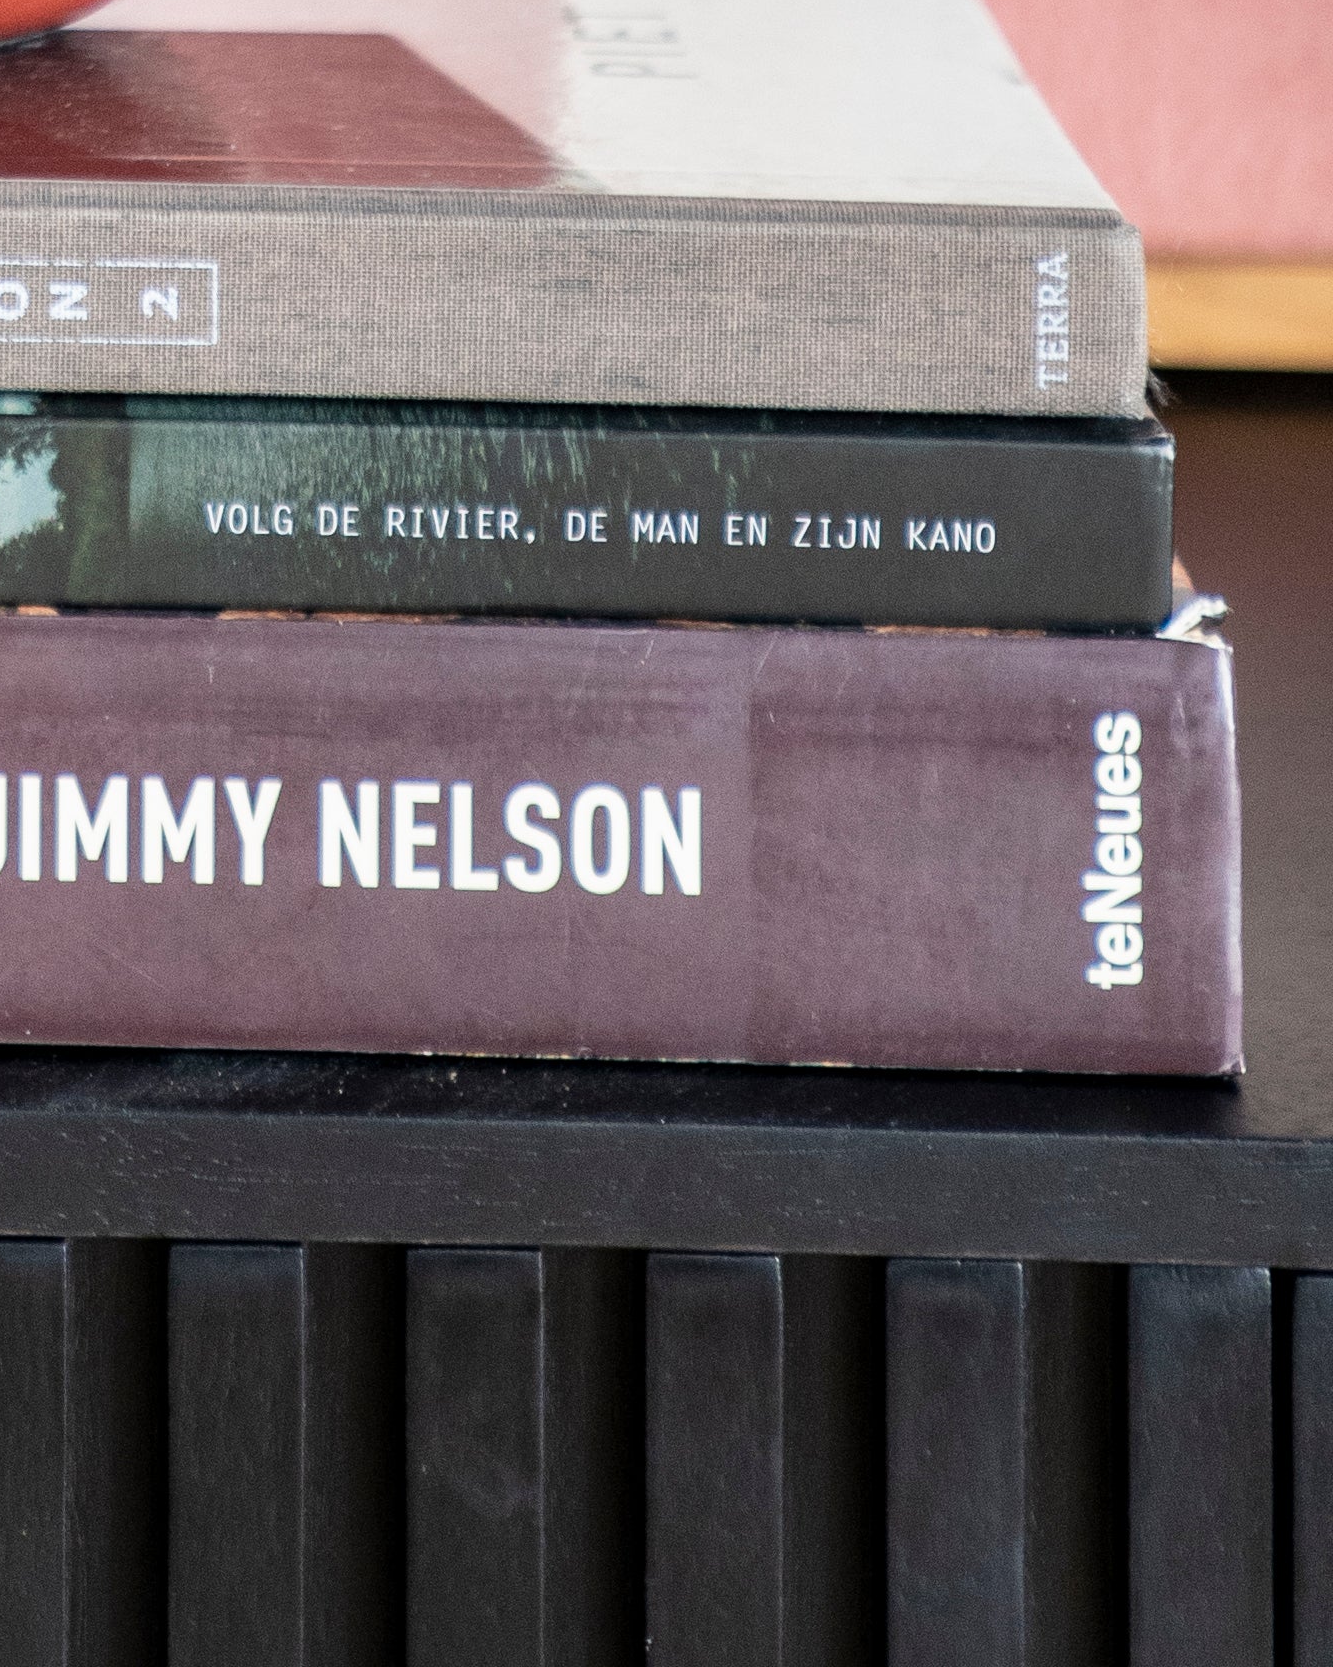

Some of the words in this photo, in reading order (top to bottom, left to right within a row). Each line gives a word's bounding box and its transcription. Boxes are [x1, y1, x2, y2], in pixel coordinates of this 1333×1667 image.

[559, 4, 701, 81] PIET
[141, 285, 180, 322] 2
[1036, 250, 1070, 391] TERRA
[205, 501, 295, 537] VOLG
[317, 503, 361, 538] DE
[385, 505, 537, 544] RIVIER,
[565, 509, 609, 544] DE
[632, 512, 700, 546] MAN
[725, 514, 768, 547] EN
[792, 516, 882, 551] ZIJN
[907, 520, 997, 555] KANO
[319, 780, 702, 896] NELSON
[1082, 713, 1144, 990] teNeues
